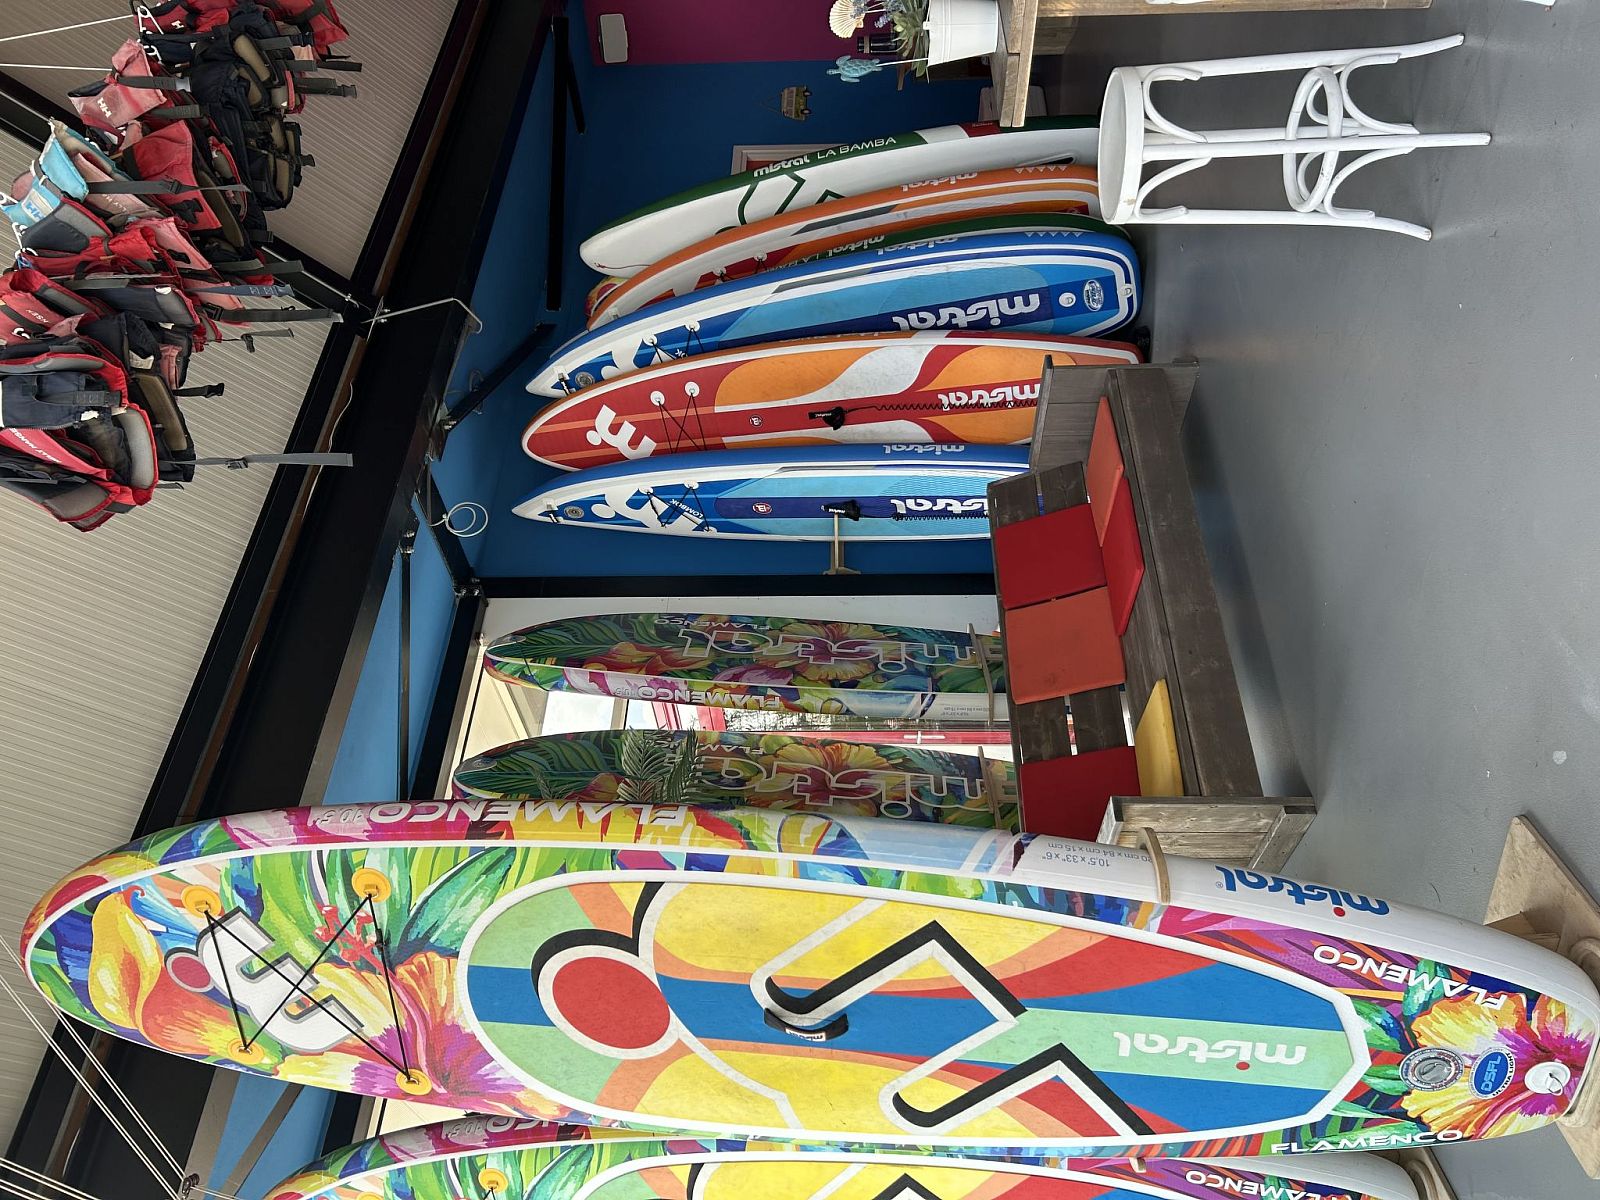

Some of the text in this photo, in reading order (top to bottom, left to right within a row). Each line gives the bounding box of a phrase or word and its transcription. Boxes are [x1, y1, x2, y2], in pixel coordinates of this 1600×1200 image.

[753, 136, 897, 178] mistral LA BAMBA
[826, 234, 885, 257] mistral
[875, 237, 959, 256] mistral
[892, 293, 1041, 331] mistral
[938, 383, 1041, 412] mistral
[882, 444, 965, 456] mistral
[669, 498, 704, 519] LOMBOK
[890, 498, 988, 516] istral
[654, 619, 770, 631] FLAMENCO
[678, 629, 982, 673] mistral
[637, 686, 780, 709] FLAMENCO
[369, 799, 688, 827] FLAMENCO
[1313, 945, 1508, 1011] FLAMENCO
[1112, 1031, 1307, 1071] mistral
[1491, 1052, 1514, 1096] ULTRA LIGHT
[1271, 1129, 1464, 1154] FLAMENCO
